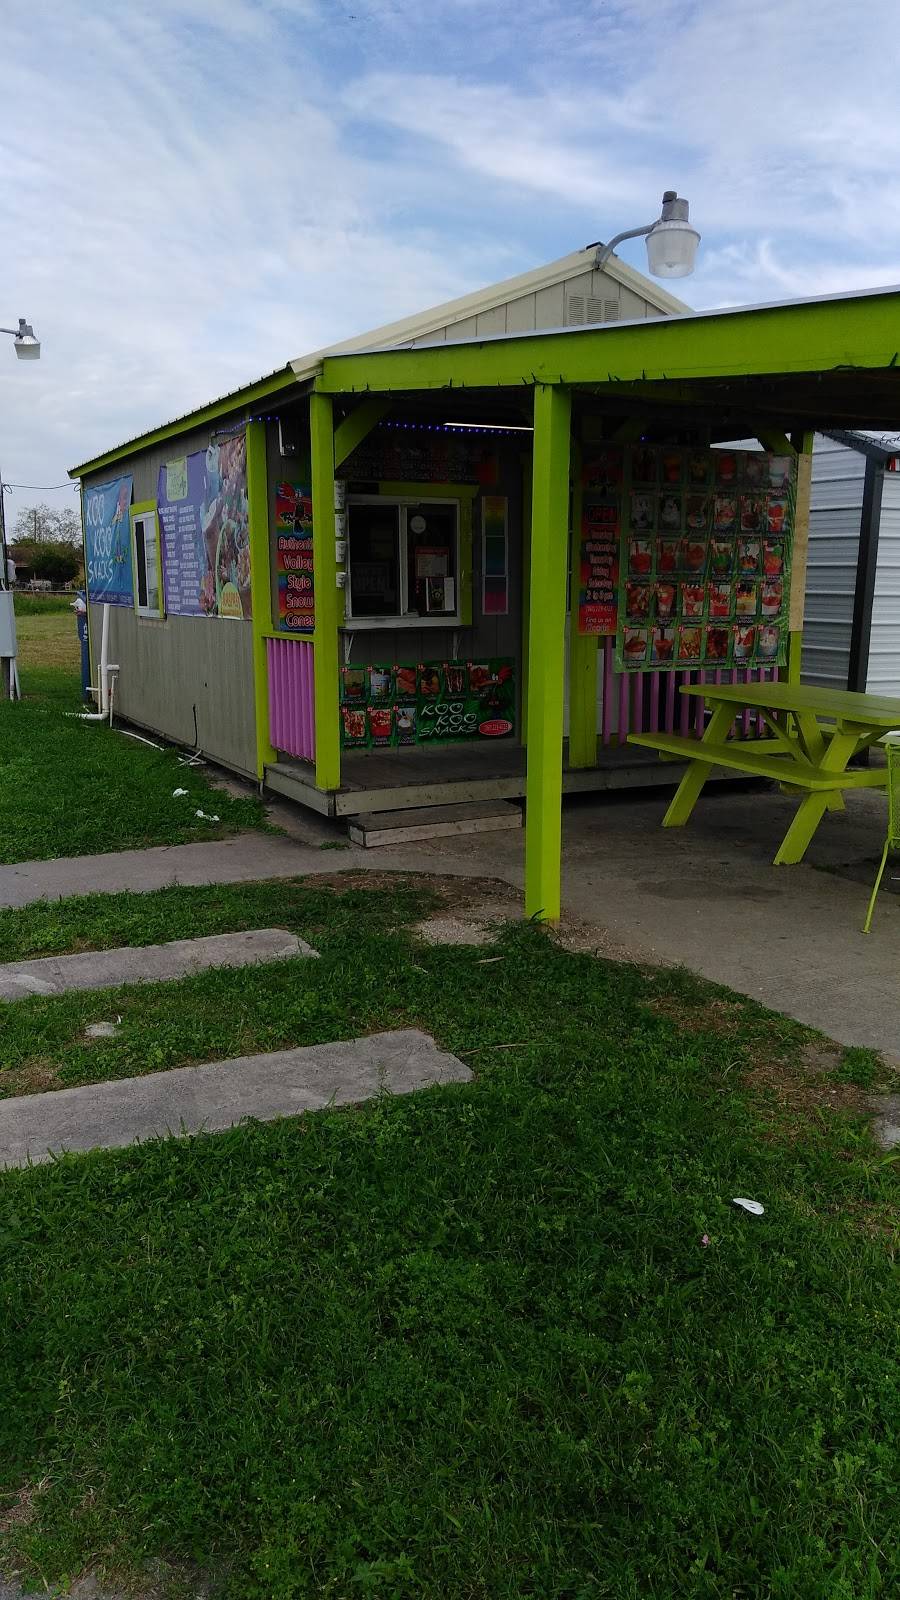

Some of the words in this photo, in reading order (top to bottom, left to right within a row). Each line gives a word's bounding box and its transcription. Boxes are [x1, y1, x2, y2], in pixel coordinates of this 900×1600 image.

[87, 493, 104, 527] KOO
[94, 526, 112, 558] KOO
[282, 554, 313, 572] Valley
[88, 559, 113, 585] SNACKS
[287, 575, 311, 592] Style
[286, 593, 313, 609] Snow
[285, 612, 314, 628] Cones
[421, 703, 464, 716] KOO
[436, 713, 477, 726] KOO
[419, 724, 477, 738] SNACKS
